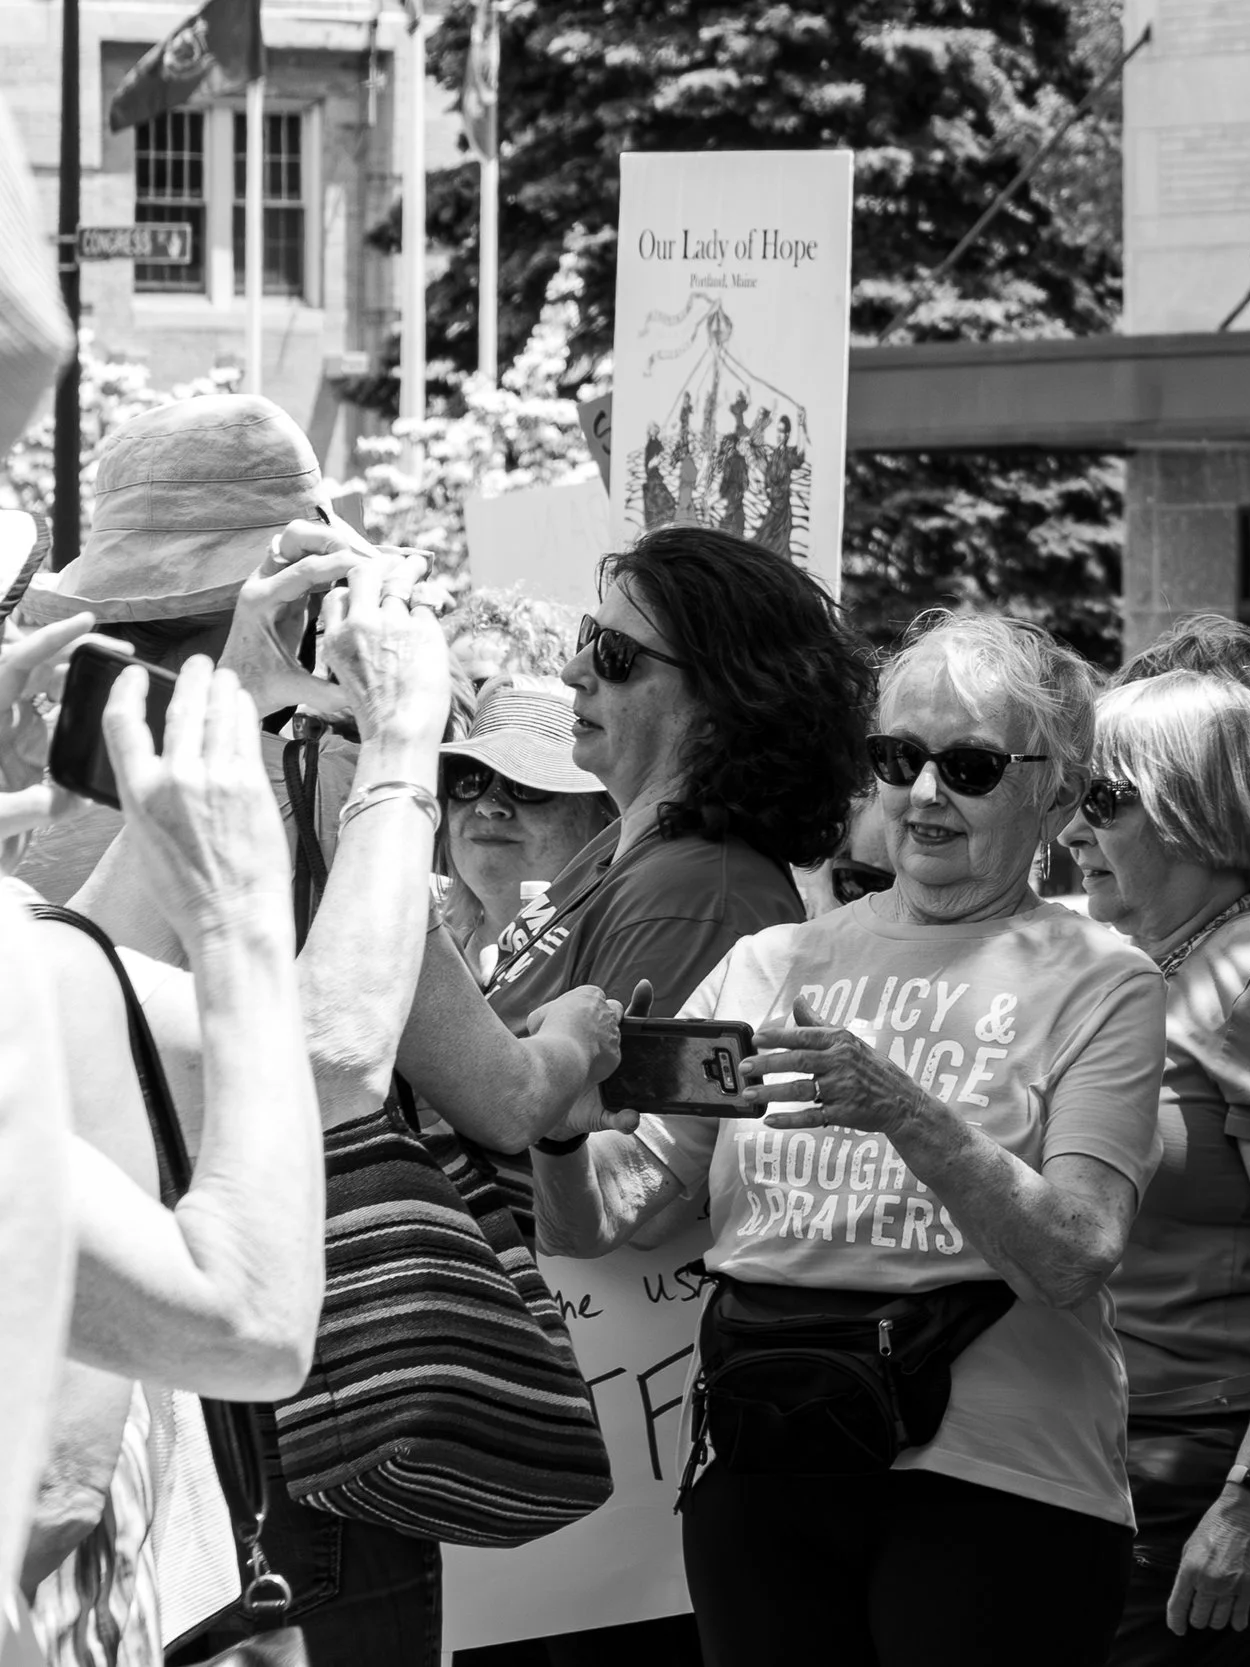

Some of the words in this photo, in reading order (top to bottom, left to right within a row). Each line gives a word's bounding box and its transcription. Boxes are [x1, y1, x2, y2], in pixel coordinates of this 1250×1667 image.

[82, 229, 152, 257] CONGRESS
[638, 228, 677, 261] Our
[682, 228, 729, 267] Lady
[734, 228, 758, 261] of
[761, 228, 818, 268] Hope
[689, 273, 728, 289] Portland,
[732, 273, 758, 288] Maine
[787, 976, 970, 1033] POLICY
[974, 992, 1018, 1044] &
[886, 1036, 1008, 1108] NGE
[734, 1130, 930, 1193] THOUGH
